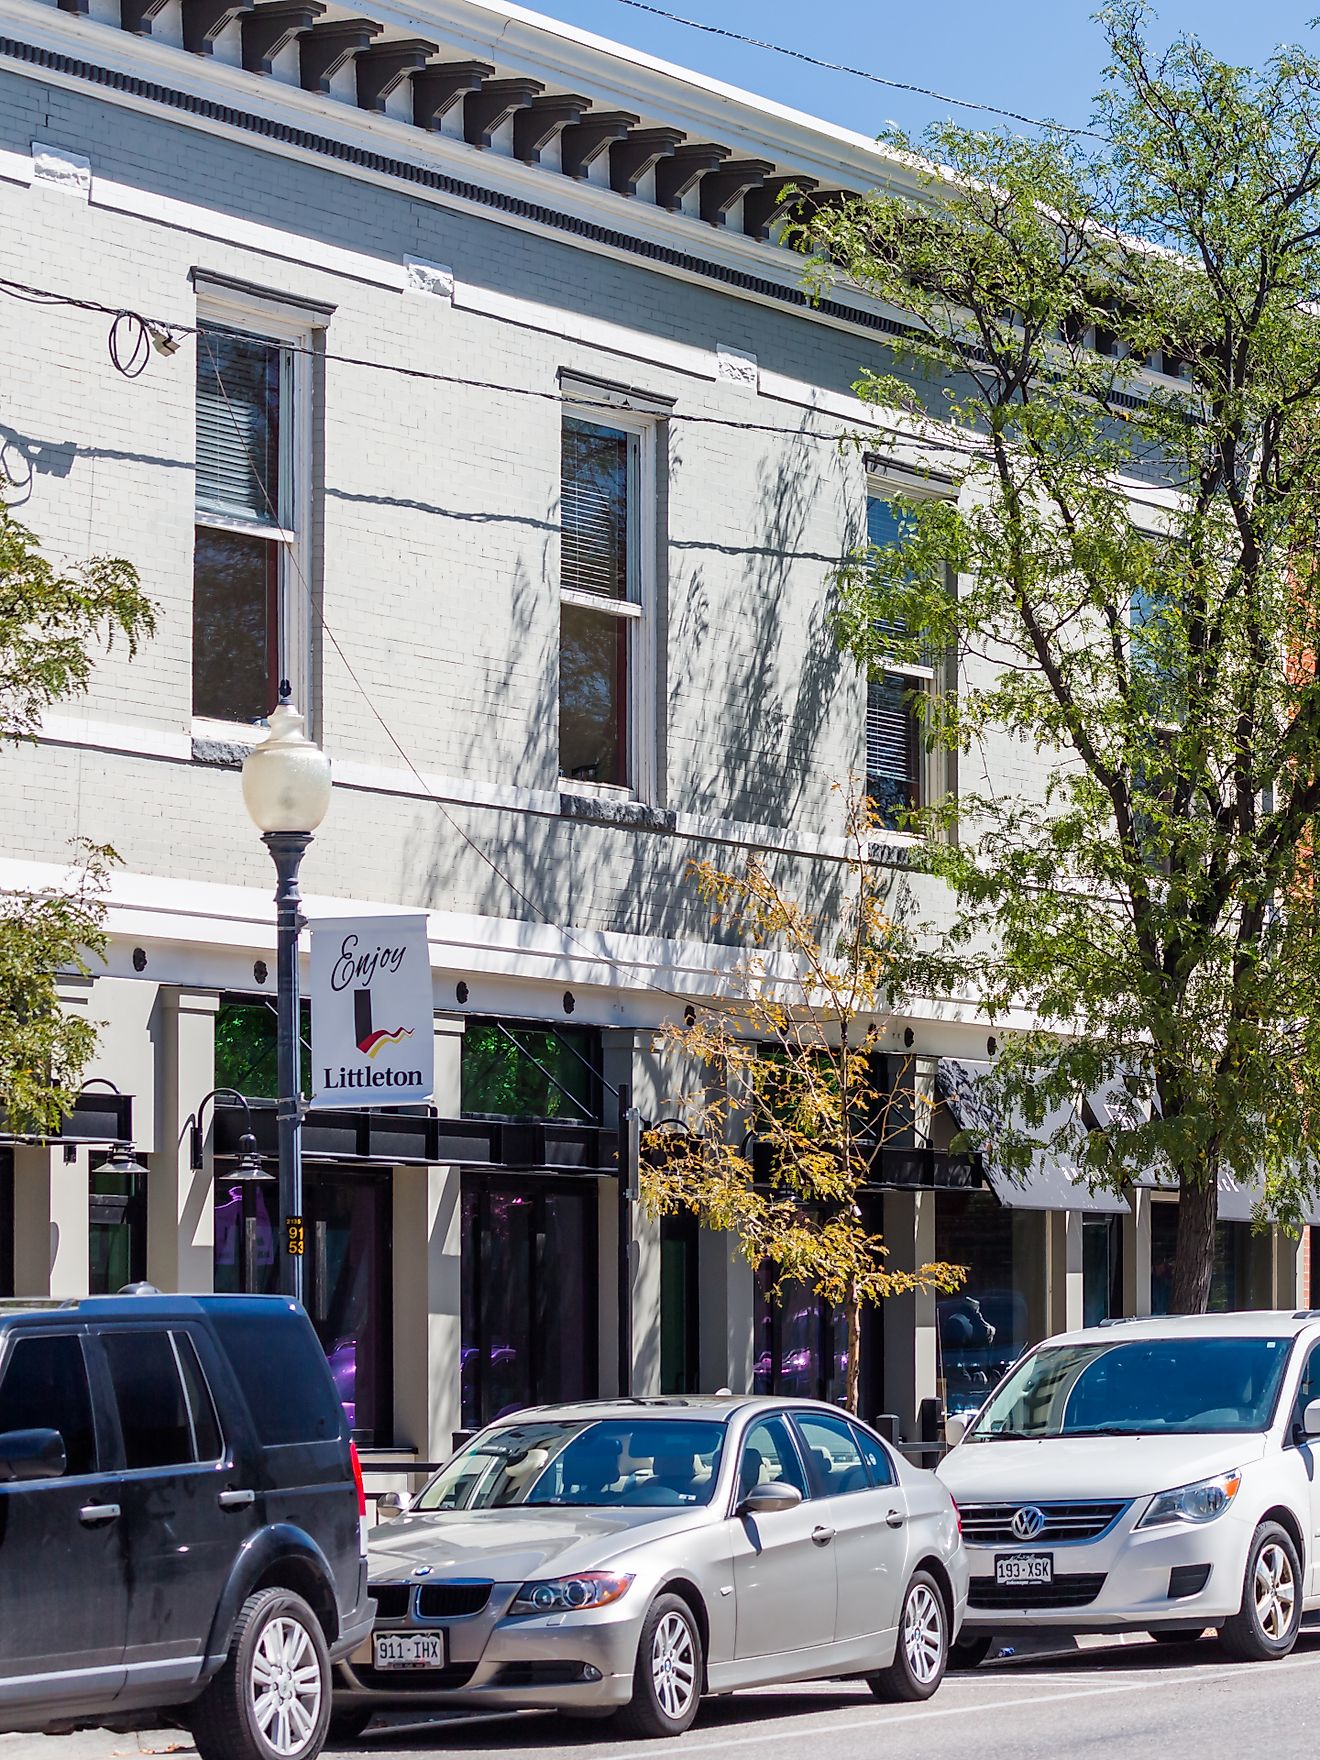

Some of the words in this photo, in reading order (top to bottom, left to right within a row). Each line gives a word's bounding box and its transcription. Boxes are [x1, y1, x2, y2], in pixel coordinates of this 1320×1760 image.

[331, 934, 407, 992] Enjoy
[323, 1066, 423, 1089] Littleton
[288, 1226, 304, 1240] 91
[288, 1240, 304, 1255] 53
